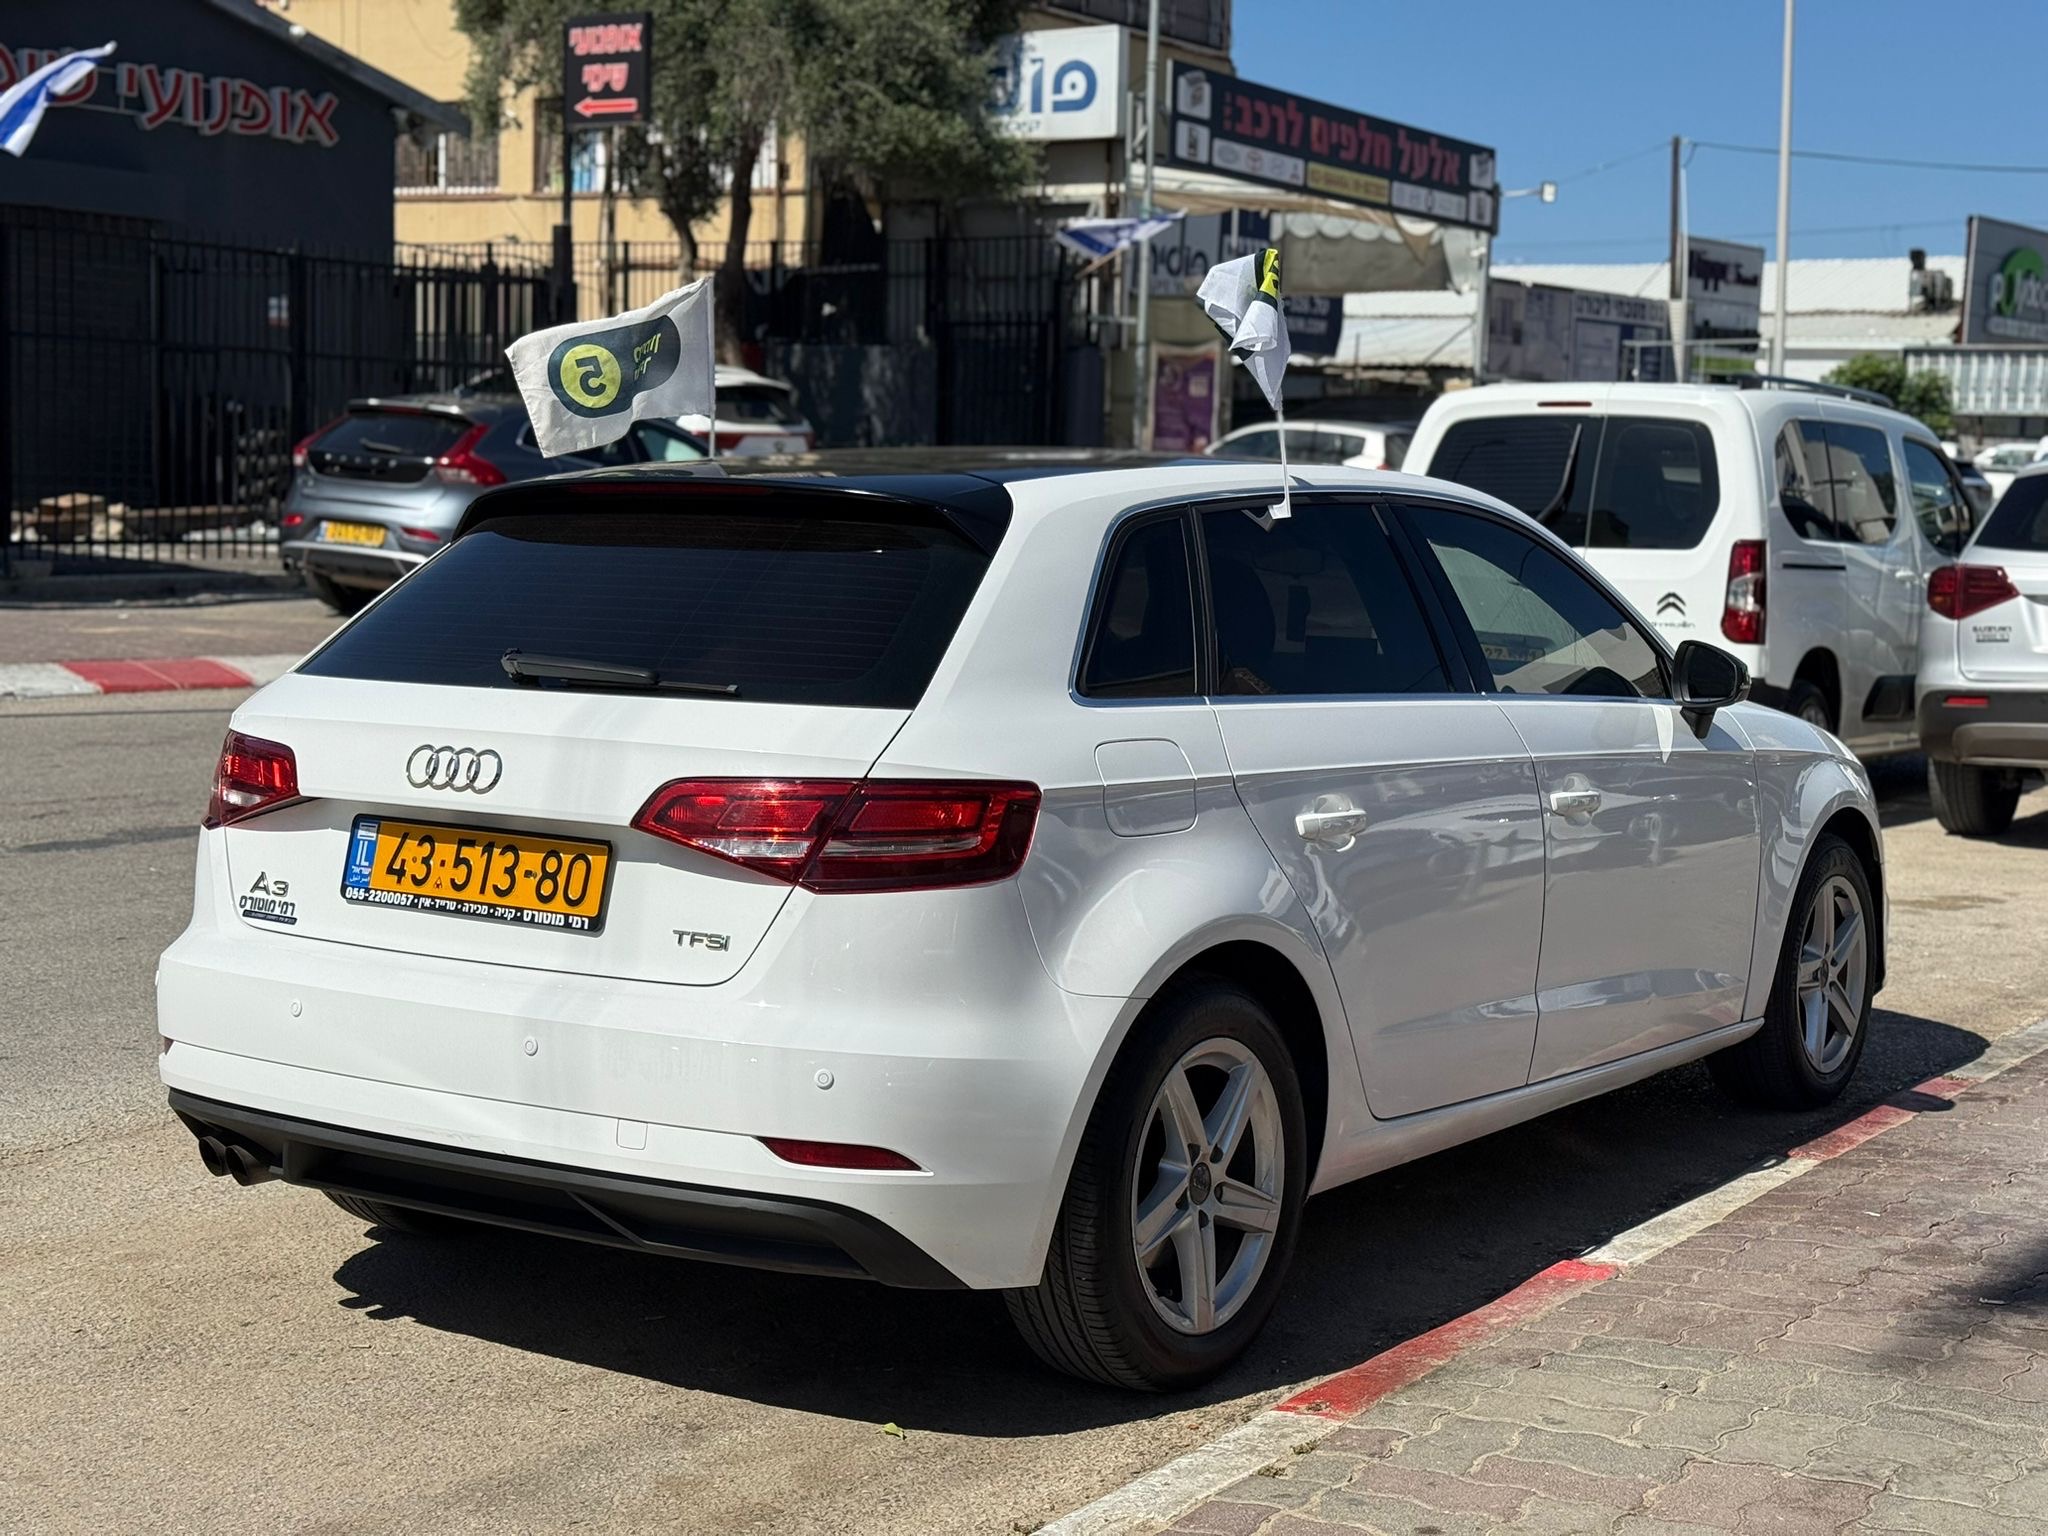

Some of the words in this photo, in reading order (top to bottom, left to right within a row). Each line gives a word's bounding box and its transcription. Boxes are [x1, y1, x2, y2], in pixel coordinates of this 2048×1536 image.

[568, 22, 643, 56] אופנועי
[117, 62, 339, 147] אופנועי
[1310, 114, 1392, 172] חלפים
[355, 839, 370, 867] IL
[249, 870, 290, 898] A3
[238, 894, 277, 914] מוטורס
[345, 886, 415, 907] 055-2200057
[418, 896, 457, 911] טרייד-אין
[278, 899, 297, 917] רמי
[462, 902, 488, 915] מכירה
[494, 907, 516, 921] קניה
[522, 909, 565, 926] מוטורס
[568, 916, 590, 930] רמי
